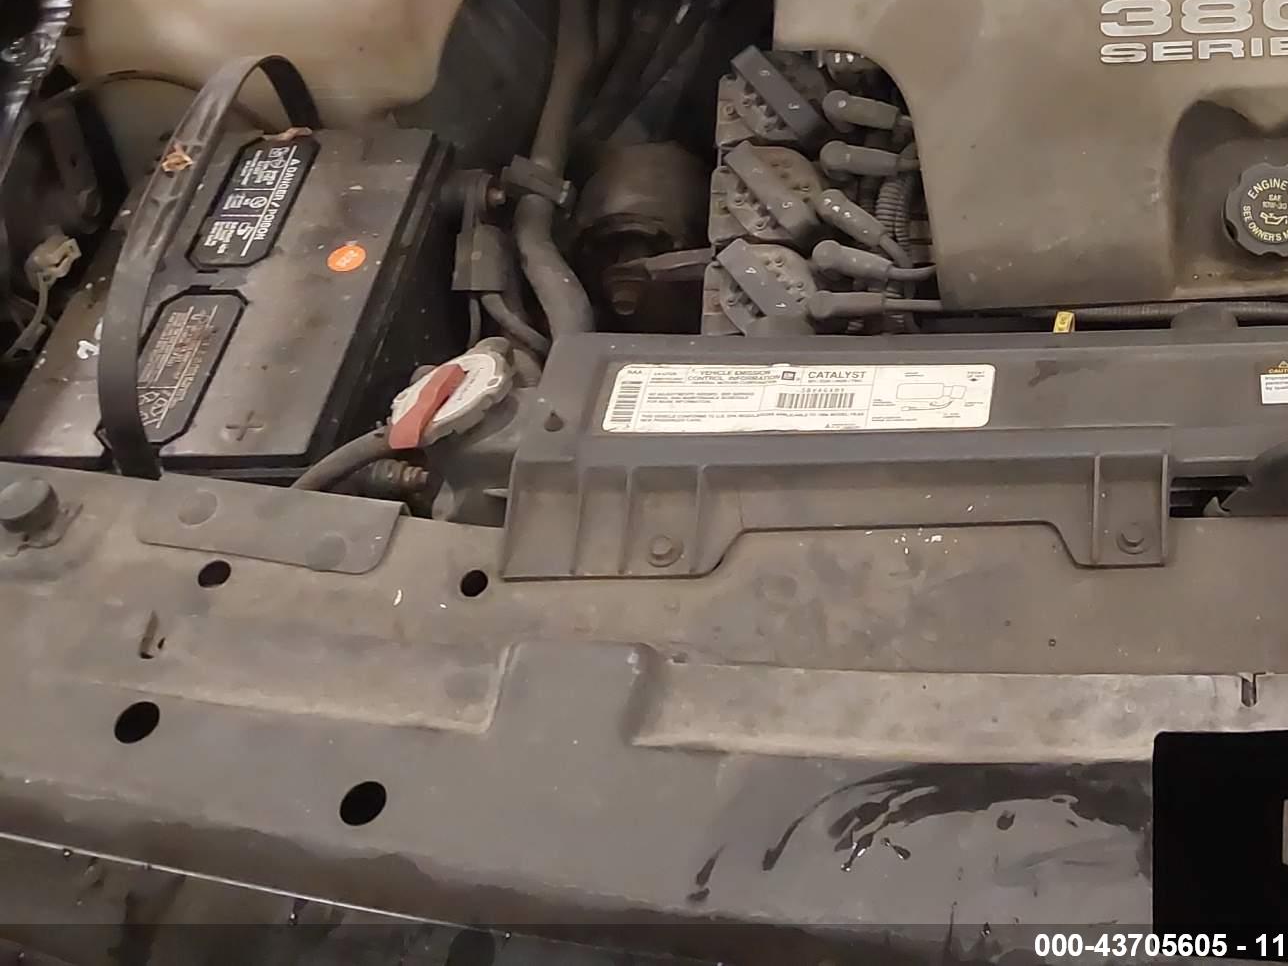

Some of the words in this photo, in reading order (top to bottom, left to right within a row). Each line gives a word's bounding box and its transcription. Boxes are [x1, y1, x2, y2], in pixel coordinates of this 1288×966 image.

[272, 166, 298, 201] DANGER
[1247, 178, 1288, 200] ENGINE
[254, 208, 278, 240] POISON
[1243, 205, 1253, 223] SEE
[808, 371, 867, 379] CATALYST
